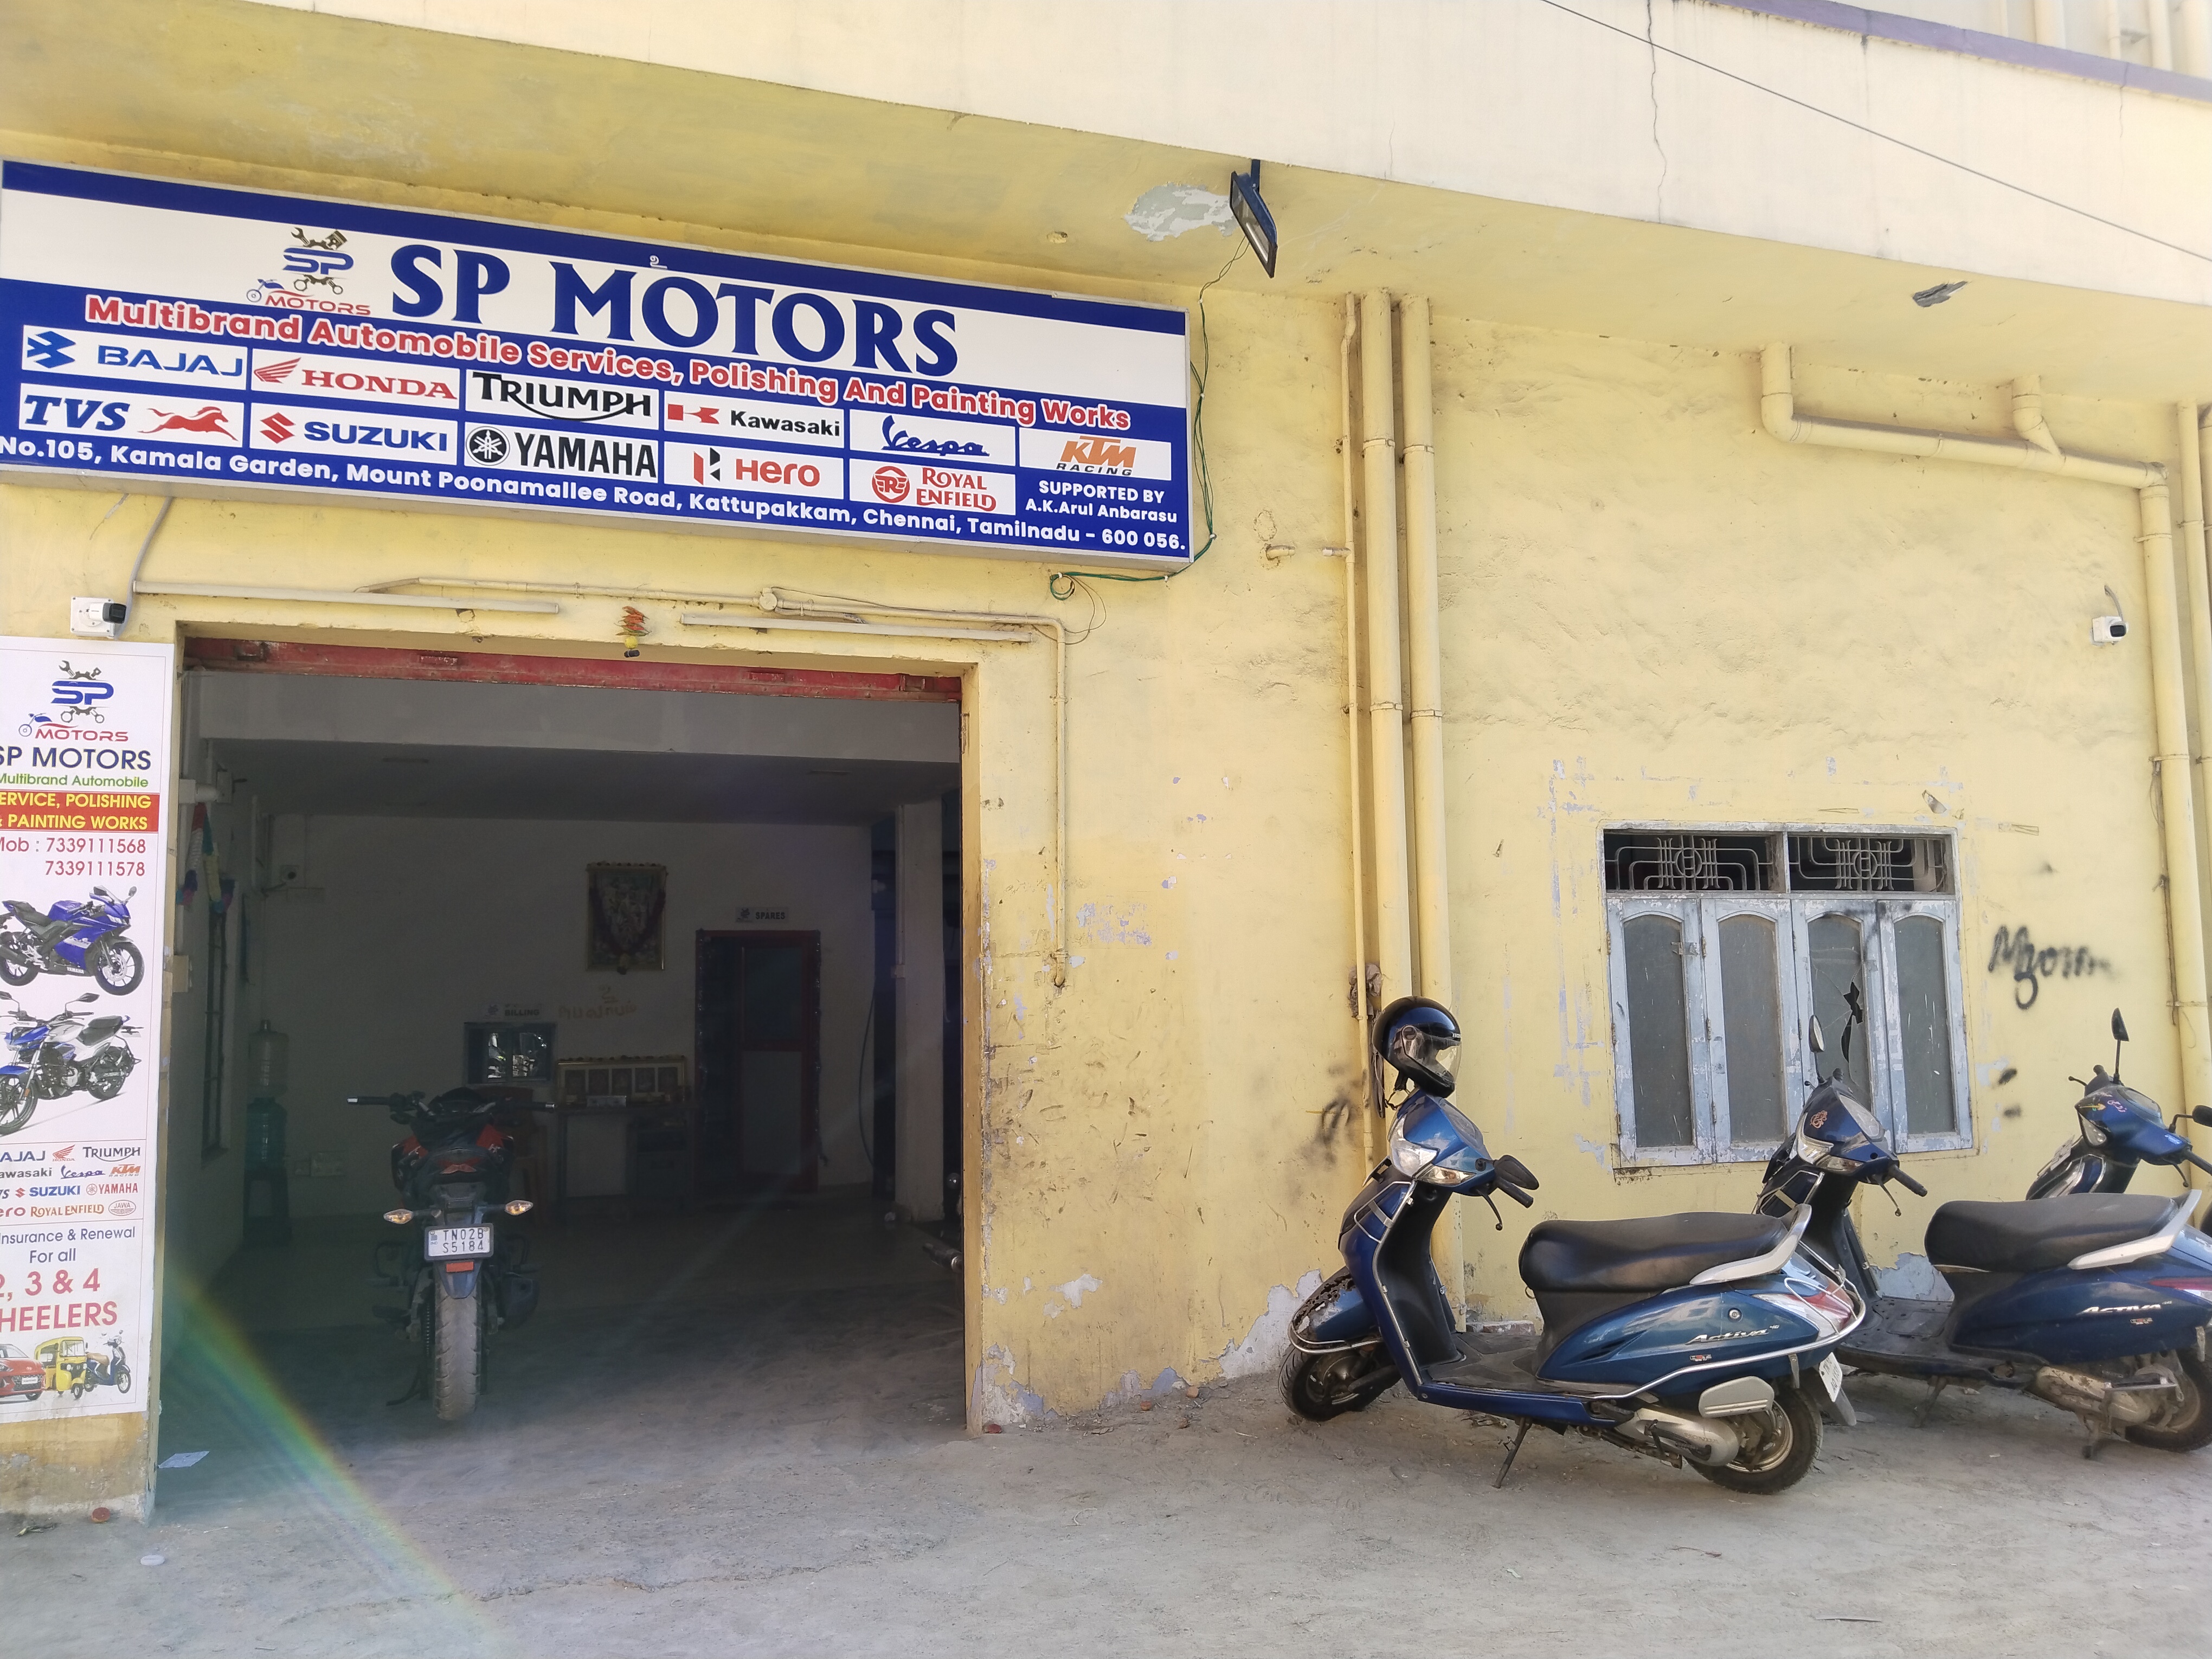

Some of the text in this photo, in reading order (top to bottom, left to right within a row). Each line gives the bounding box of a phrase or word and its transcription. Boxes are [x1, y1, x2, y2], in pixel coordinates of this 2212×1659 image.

[282, 247, 354, 275] SP
[265, 294, 371, 316] MOTORS
[390, 244, 958, 376] SP MOTORS
[87, 296, 1131, 429] Multibrand Automobile Services, Polishing And Painting Works
[97, 344, 243, 377] BAJAJ
[301, 369, 458, 400] HONDA
[473, 372, 652, 422] TRIUMPH
[23, 395, 131, 432] TVS
[730, 409, 840, 437] Kawasaki
[304, 421, 447, 452] SUZUKI
[880, 414, 991, 457] Vespa
[514, 432, 658, 479] YAMAHA
[1059, 435, 1137, 467] KTM
[922, 466, 988, 491] ROYAL
[1055, 462, 1133, 477] RACING
[0, 436, 102, 465] No.105,
[111, 445, 222, 472] Kamala
[229, 455, 339, 483] Garden,
[346, 465, 432, 487] Mount
[439, 470, 607, 502] Poonamallee
[614, 487, 683, 511] Road,
[689, 493, 857, 526] Kattupakkam,
[863, 509, 962, 535] Chennai,
[967, 515, 1081, 543] Tamilnadu
[1101, 529, 1139, 546] 600
[1143, 531, 1187, 550] 056.
[916, 488, 997, 512] ENFIELD
[1039, 480, 1165, 505] SUPPORTED BY
[1026, 499, 1178, 524] A.K.Arul Anbarasu
[50, 680, 114, 705] SP
[35, 728, 129, 742] MOTORS
[32, 747, 152, 770] MOTORS
[72, 775, 149, 788] Automobile
[66, 794, 152, 809] POLISHING
[8, 814, 86, 829] PAINTING
[91, 816, 148, 830] WORKS
[46, 837, 146, 854] 7339111568
[44, 860, 146, 876] 7339111578
[82, 1147, 141, 1162] TRIUMPH
[60, 1165, 106, 1180] Vespa
[110, 1164, 141, 1174] KTM
[29, 1185, 81, 1197] SUZUKI
[99, 1182, 138, 1194] YAMAHA
[30, 1206, 63, 1218] ROYAL
[65, 1204, 105, 1216] ENFIELD
[67, 1229, 76, 1240] &
[81, 1226, 136, 1240] Renewal
[442, 1227, 484, 1242] TN02B
[29, 1248, 76, 1263] For all
[442, 1240, 484, 1253] S5184
[24, 1271, 42, 1296] 3
[53, 1269, 74, 1295] &
[82, 1268, 100, 1292] 4
